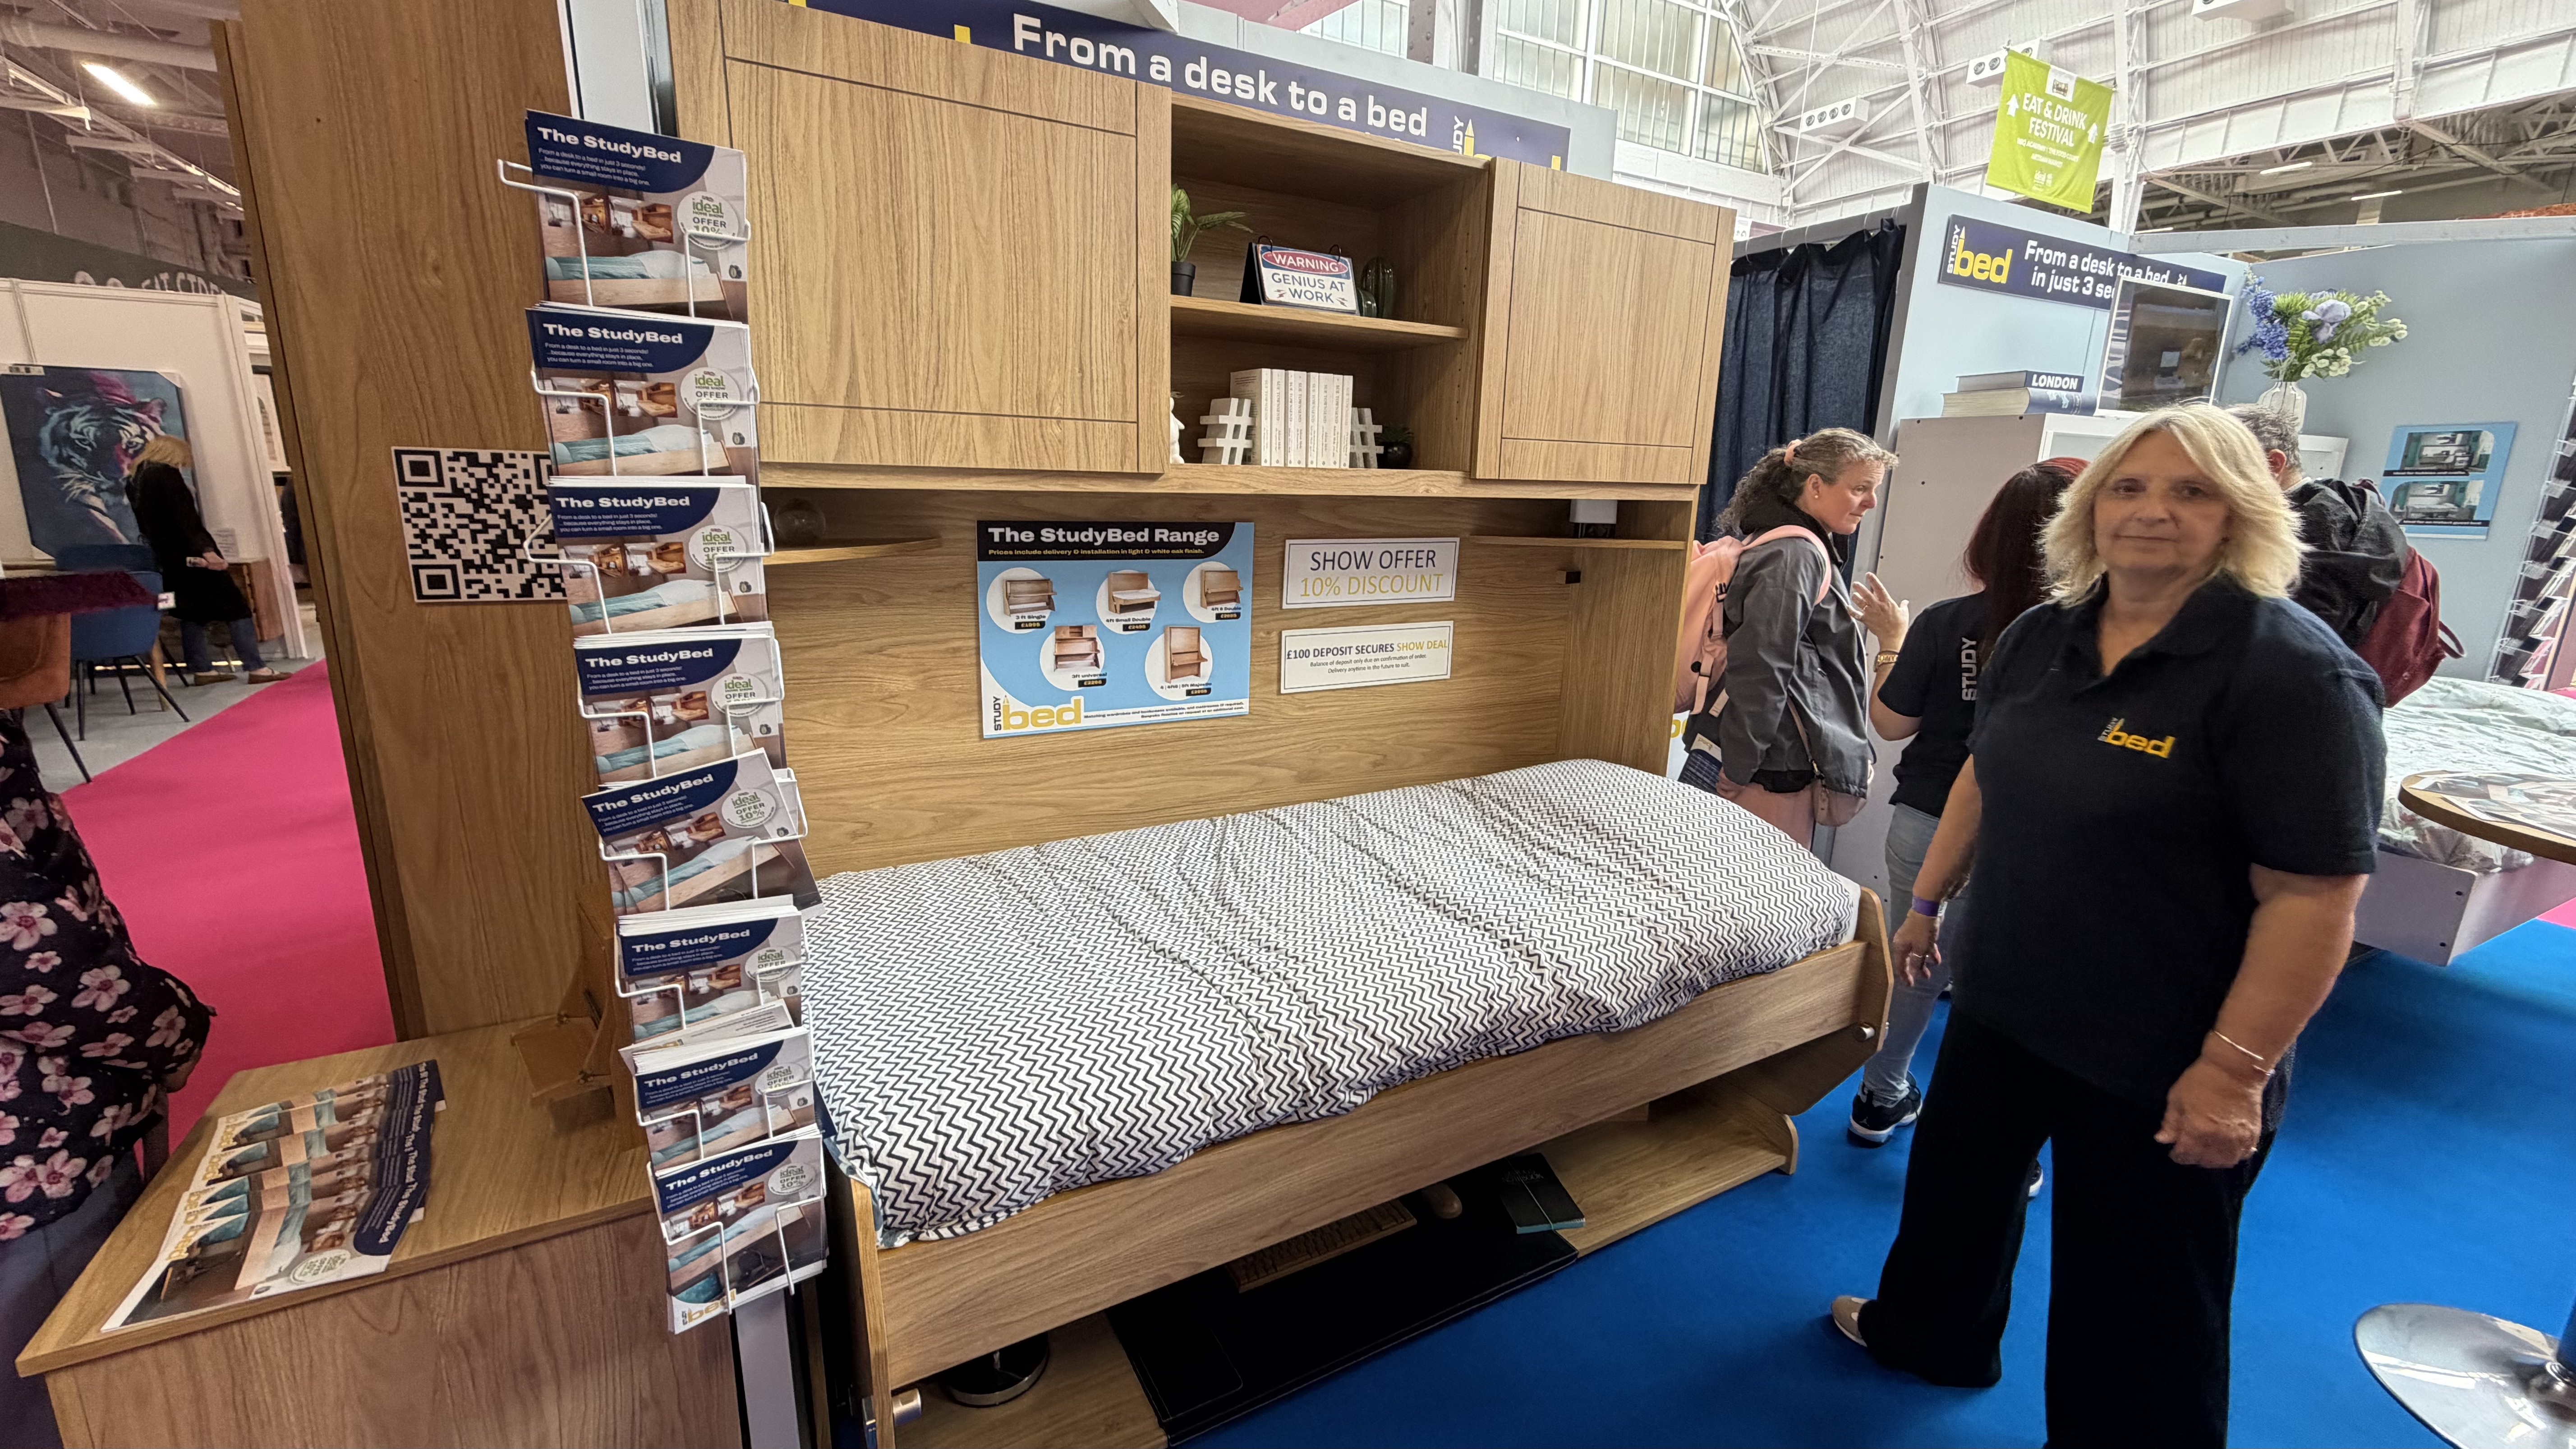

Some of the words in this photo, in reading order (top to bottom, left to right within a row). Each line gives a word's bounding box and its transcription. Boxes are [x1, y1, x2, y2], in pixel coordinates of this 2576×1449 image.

[1013, 13, 1136, 75] From
[1150, 54, 1172, 83] a
[1185, 56, 1278, 106] desk
[1288, 80, 1328, 116] to
[1338, 97, 1356, 122] a
[1367, 95, 1427, 137] bed
[2023, 92, 2042, 115] EAT
[2043, 101, 2052, 119] &
[2054, 103, 2088, 130] DRINK
[1453, 115, 1465, 155] UDY
[2028, 117, 2075, 147] FESTIVAL
[537, 127, 579, 144] The
[584, 135, 682, 163] StudyBed
[692, 198, 724, 215] ideal
[693, 216, 727, 228] OFFER
[1946, 225, 1960, 274] STUDY
[1953, 225, 2013, 284] bed
[1272, 253, 1340, 272] WARNING
[2024, 240, 2066, 267] From
[2069, 254, 2079, 269] a
[2081, 253, 2115, 277] desk
[2118, 262, 2132, 276] to
[2134, 269, 2143, 279] a
[2145, 266, 2170, 284] bed
[1271, 272, 1325, 290] GENIUS
[1329, 280, 1345, 292] AT
[2031, 266, 2046, 287] in
[2047, 270, 2079, 294] just
[2082, 276, 2093, 295] 3
[1288, 287, 1334, 304] WORK
[543, 324, 583, 336] The
[588, 327, 683, 344] StudyBed
[694, 374, 726, 387] ideal
[2032, 374, 2078, 390] LONDON
[695, 391, 728, 399] OFFER
[555, 498, 595, 508] The
[598, 496, 690, 509] StudyBed
[701, 531, 732, 542] ideal
[988, 527, 1035, 542] The
[1040, 528, 1149, 546] StudyBed
[1155, 529, 1219, 546] Range
[1310, 551, 1374, 571] SHOW
[1379, 550, 1436, 570] OFFER
[1300, 576, 1341, 597] 10%
[1348, 573, 1444, 595] DISCOUNT
[585, 658, 622, 667] The
[626, 648, 713, 664] StudyBed
[1287, 649, 1310, 660] £100
[1313, 646, 1353, 658] DEPOSIT
[1355, 643, 1394, 655] SECURES
[1397, 640, 1425, 652] SHOW
[1427, 639, 1448, 649] DEAL
[1962, 637, 1977, 701] STUDY
[724, 679, 752, 689] ideal
[993, 696, 1001, 731] STUDY
[1003, 695, 1082, 731] bed
[2098, 718, 2118, 741] STUDY
[2106, 718, 2176, 758] bed
[592, 800, 628, 812] The
[630, 774, 714, 803] StudyBed
[731, 792, 760, 806] ideal
[736, 802, 765, 814] OFFER
[738, 809, 765, 821] 10%
[632, 943, 666, 952] The
[670, 929, 750, 947] StudyBed
[644, 1076, 677, 1088] The
[681, 1053, 759, 1079] StudyBed
[666, 1175, 696, 1191] The
[699, 1149, 773, 1178] StudyBed
[780, 1165, 805, 1177] ideal
[780, 1174, 806, 1184] OFFER
